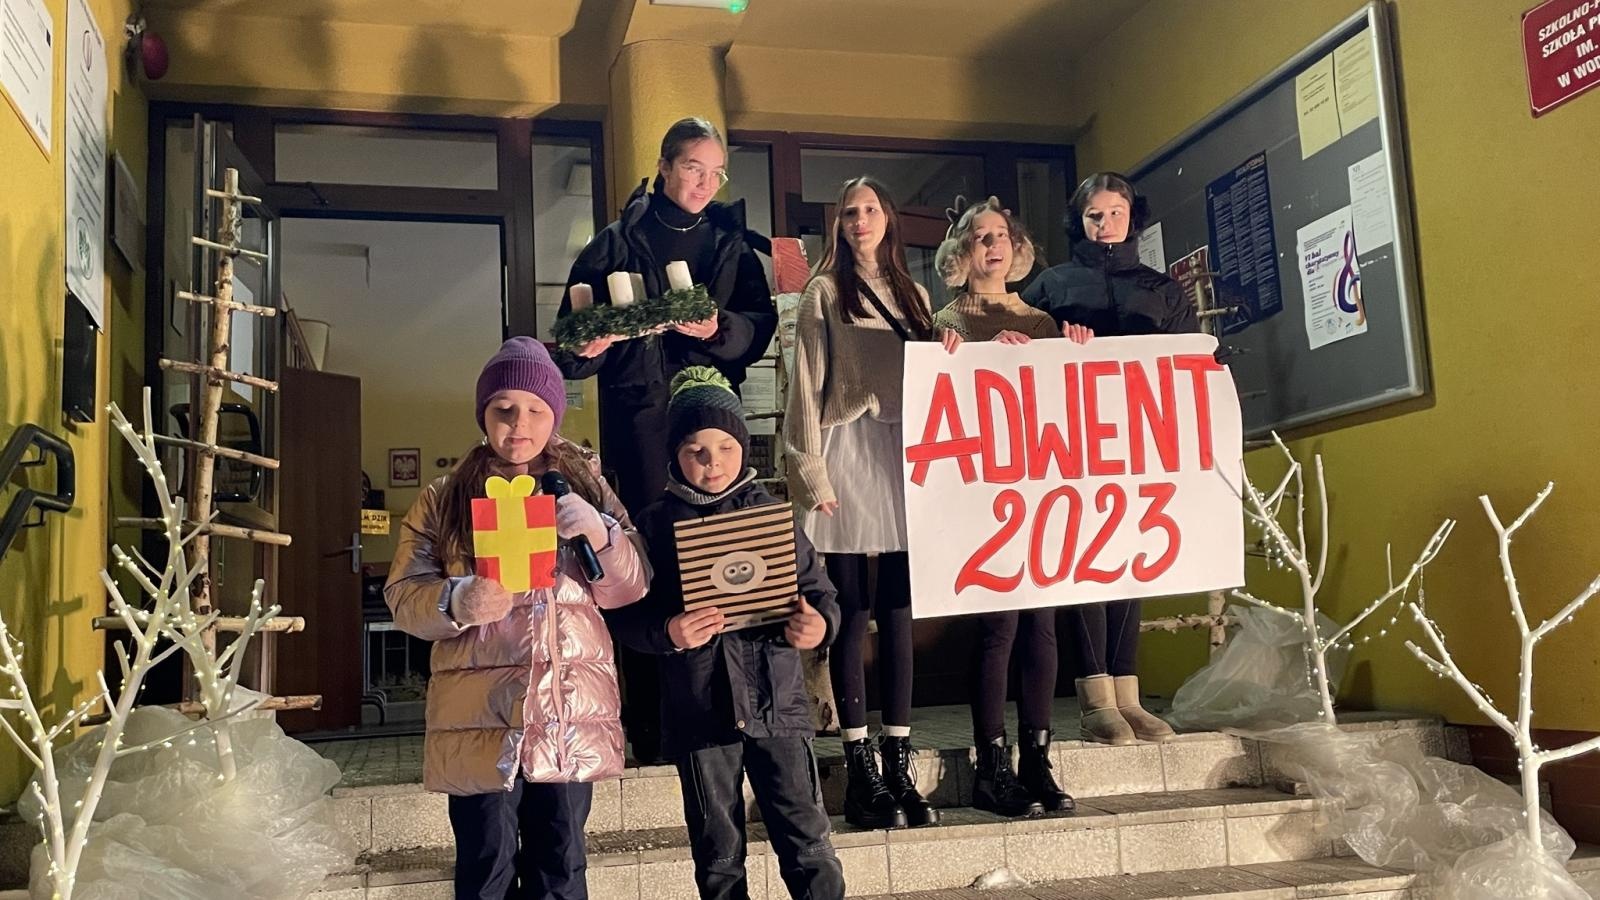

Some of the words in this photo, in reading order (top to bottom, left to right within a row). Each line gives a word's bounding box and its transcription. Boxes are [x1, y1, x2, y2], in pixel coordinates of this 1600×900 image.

[1542, 24, 1586, 58] SZKOŁA
[1576, 38, 1599, 58] IM.
[1557, 72, 1571, 88] W
[905, 354, 1225, 487] ADWENT
[954, 482, 1182, 595] 2023
